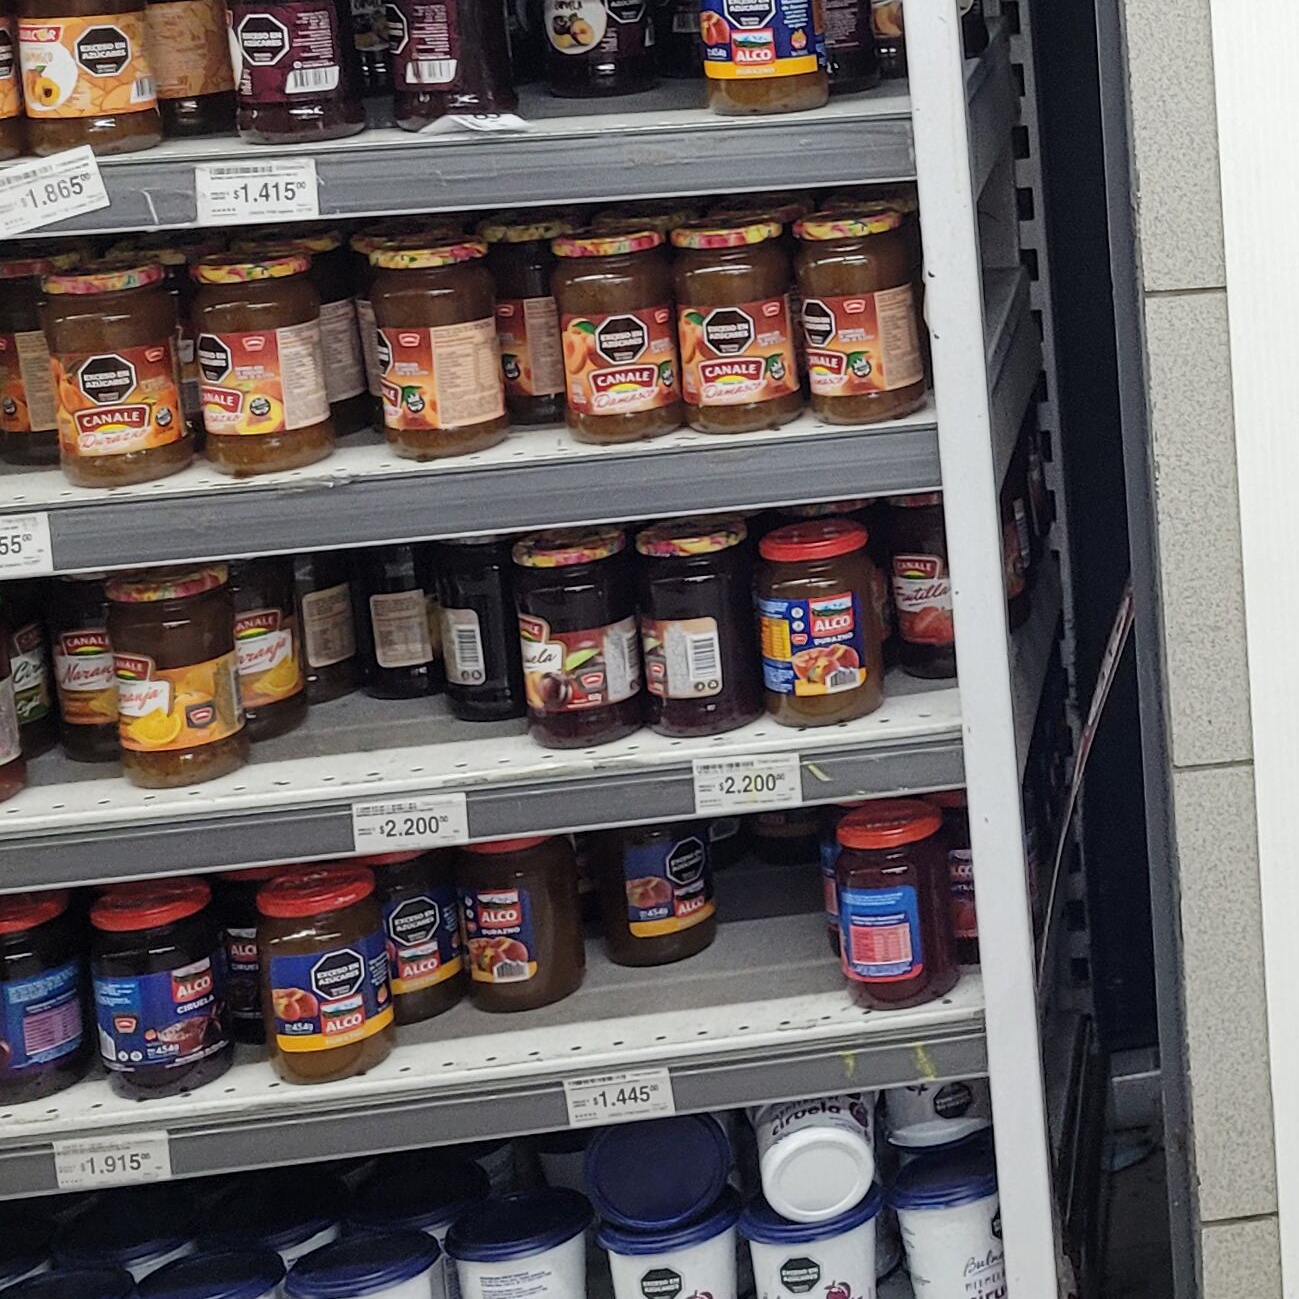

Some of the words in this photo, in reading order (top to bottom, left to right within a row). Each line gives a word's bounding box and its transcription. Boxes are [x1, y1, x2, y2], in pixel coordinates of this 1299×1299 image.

[735, 48, 772, 62] ALCO
[234, 182, 296, 203] $1.415
[597, 372, 651, 385] CANALE
[705, 364, 762, 377] CANALE
[83, 411, 140, 426] CANALE
[815, 615, 851, 631] ALCO
[719, 774, 775, 794] $2.200
[379, 818, 439, 838] $2.200
[481, 909, 517, 922] ALCO
[403, 958, 438, 977] ALCO
[176, 975, 211, 997] ALCO
[177, 995, 214, 1014] CIRUELA
[325, 1014, 362, 1032] ALCO
[594, 1087, 650, 1107] $1.445
